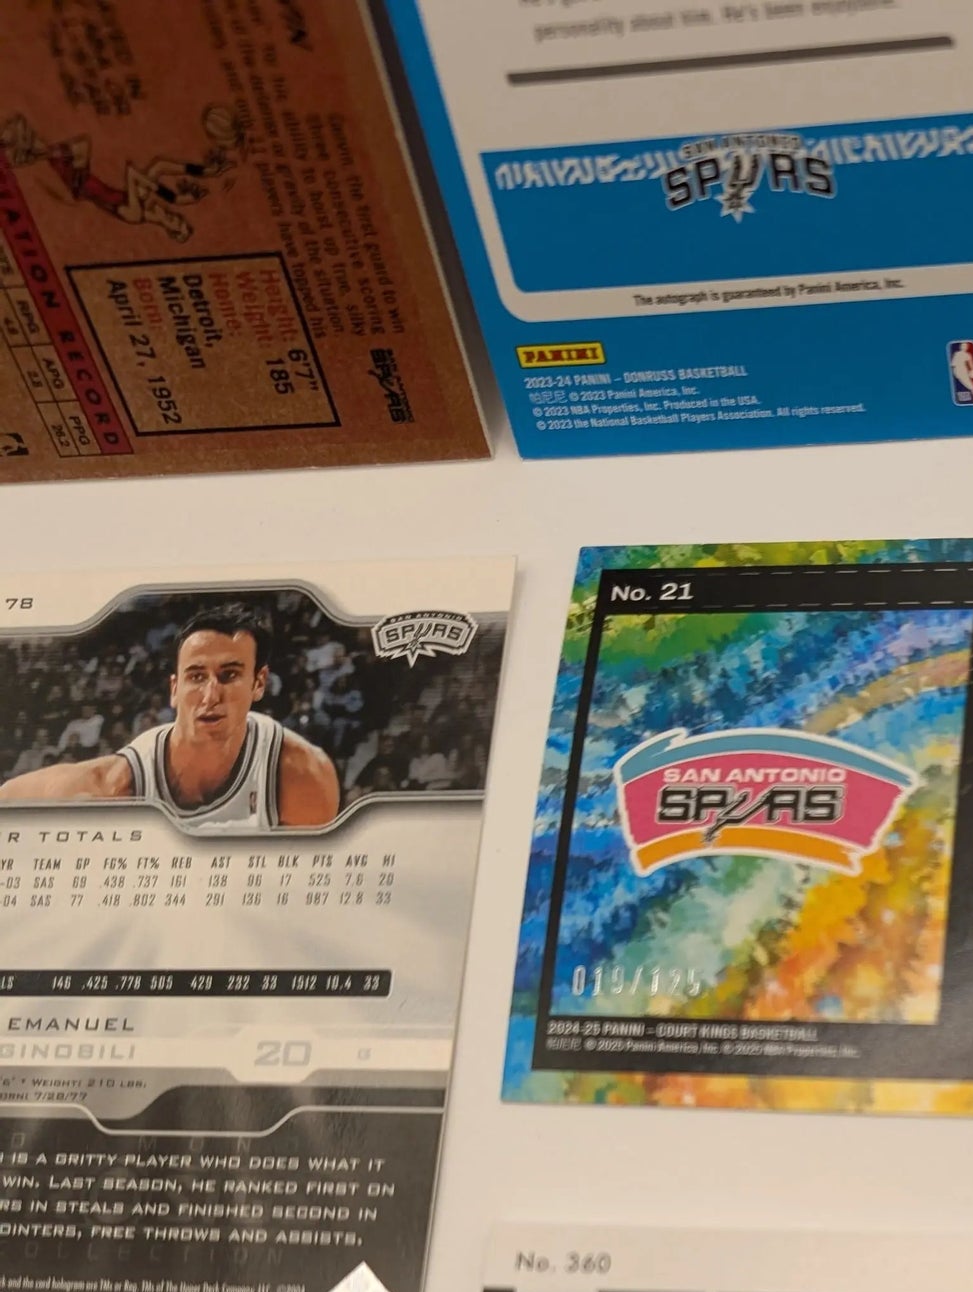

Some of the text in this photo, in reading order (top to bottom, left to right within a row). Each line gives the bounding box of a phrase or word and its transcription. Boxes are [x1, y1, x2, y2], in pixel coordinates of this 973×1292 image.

[662, 152, 837, 212] SPURS
[656, 282, 833, 306] autograph guaranteed Panini
[18, 300, 40, 334] RPG
[183, 273, 223, 348] Detroit,
[158, 276, 206, 370] Michigan
[107, 279, 182, 425] April 27, 1952
[523, 347, 599, 363] PANINI
[43, 357, 65, 389] APG
[266, 357, 295, 395] 185
[524, 364, 748, 389] 2023-24 PANINI DONRUSS BASKETBALL
[58, 328, 119, 446] RECORD
[581, 388, 637, 401] 2023 Panini
[543, 397, 708, 417] 2023 NBA Properties, Produced
[547, 402, 867, 431] 2023 the National Basketball Players rights reserved.
[70, 415, 91, 446] PPG
[611, 582, 694, 602] No. 21
[384, 622, 464, 644] SPURS
[663, 767, 847, 783] SAN ANTONIO
[655, 785, 847, 846] SPURS
[39, 830, 143, 843] TOTALS
[33, 854, 396, 871] TEAM GP FG% FT% REB AST STL BLK PTS AVG HI
[33, 872, 395, 890] SAS 69 161 138 96 17 525 20
[30, 891, 392, 908] SAS 77 344 291 136 16 987 33
[52, 975, 380, 991] 146 429 232 33 1512 33
[572, 964, 700, 997] 019/125
[8, 1016, 135, 1032] EMANUEL
[546, 1021, 819, 1042] 2024-25 PANINI COURT KINGS BASKETBALL
[254, 1040, 313, 1067] 20
[12, 1152, 386, 1173] IS A GRITTY PLAYER WHO DOES WHAT IT
[3, 1174, 396, 1198] WIN. LAST SEASON, HE RANKED FIRST ON
[30, 1199, 378, 1222] IN STEALS AND FINISHED SECOND IN
[91, 1224, 268, 1244] FREE THROWS AND
[516, 1250, 612, 1274] No. 360
